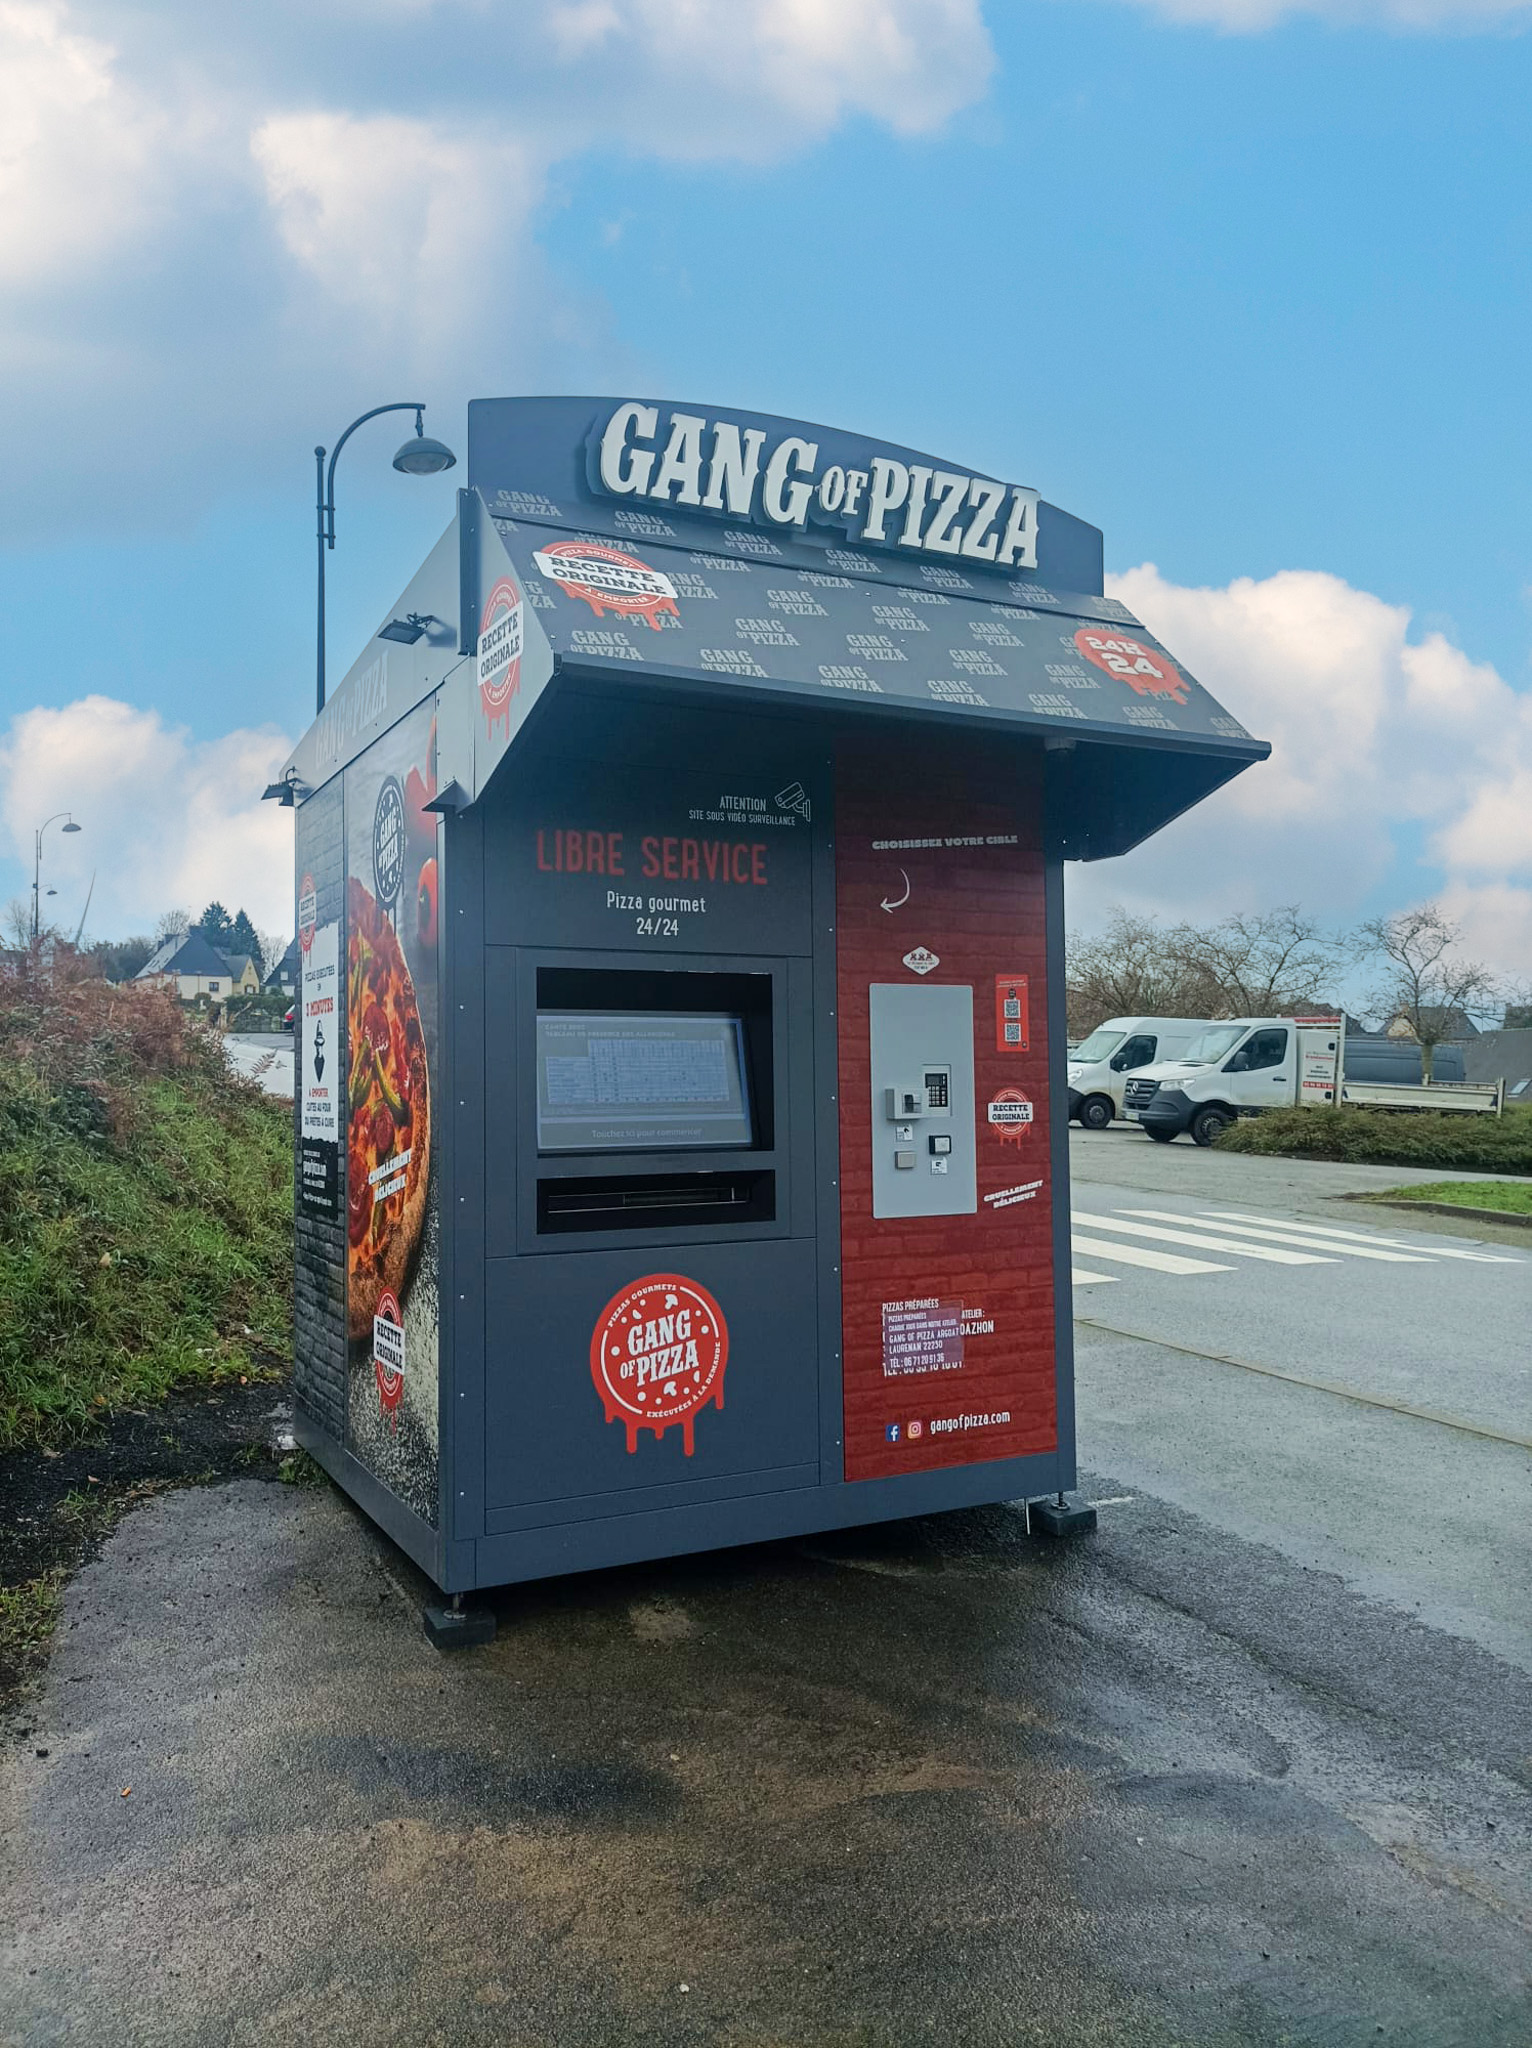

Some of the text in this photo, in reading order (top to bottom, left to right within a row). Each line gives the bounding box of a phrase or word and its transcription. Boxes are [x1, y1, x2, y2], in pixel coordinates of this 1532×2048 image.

[600, 402, 1041, 569] GANG OF PIZZA
[498, 490, 550, 504] GANG
[510, 502, 562, 516] PIZZA
[615, 511, 664, 525] GANG
[626, 523, 677, 537] PIZZA
[724, 531, 770, 543] GANG
[736, 542, 783, 555] PIZZA
[825, 549, 868, 561] GANG
[549, 556, 655, 582] RECETTE
[701, 558, 751, 572] PIZZA
[839, 560, 882, 573] PIZZA
[920, 566, 960, 578] GANG
[553, 568, 666, 594] ORIGINALE
[665, 572, 705, 586] ANG
[807, 575, 855, 588] PIZZA
[933, 577, 974, 589] PIZZA
[676, 585, 719, 599] IZZA
[767, 590, 815, 603] GANG
[907, 592, 951, 605] PIZZA
[780, 602, 829, 616] PIZZA
[872, 605, 917, 619] GANG
[735, 618, 786, 632] GANG
[885, 618, 930, 631] PIZZA
[968, 622, 1011, 634] GANG
[481, 611, 518, 654] RECETTE
[571, 630, 630, 645] GANG
[748, 632, 800, 646] PIZZA
[846, 634, 894, 647] GANG
[981, 634, 1025, 646] PIZZA
[1084, 636, 1147, 656] 24H
[480, 635, 520, 677] ORIGINALE
[584, 645, 644, 660] PIZZA
[700, 648, 754, 663] GANG
[860, 647, 909, 661] PIZZA
[949, 649, 994, 662] GANG
[713, 663, 770, 677] PIZZA
[818, 665, 869, 679] GANG
[963, 662, 1008, 676] PIZZA
[1044, 664, 1087, 676] GANG
[1101, 652, 1164, 679] 24
[832, 679, 885, 693] PIZZA
[927, 680, 975, 693] GANG
[1060, 677, 1102, 688] PIZZA
[352, 648, 388, 738] PIZZA
[941, 693, 991, 707] PIZZA
[1028, 694, 1072, 706] GANG
[719, 795, 767, 811] ATTENTION
[688, 809, 796, 826] SITE SOUS VIDÉO SURVEILLANCE
[380, 805, 397, 849] GANG
[872, 835, 1018, 850] CHOISISSEZ VOTRE CIBLE
[382, 831, 399, 875] PIZZA
[536, 830, 768, 885] LIBRE SERVICE
[607, 890, 706, 913] Pizza gourmet
[636, 917, 679, 936] 24/24
[992, 1104, 1028, 1112] RECETTE
[991, 1112, 1030, 1121] ORIGINALE
[983, 1179, 1044, 1202] CRUELLEMENT
[608, 1284, 677, 1327] PIZZAS GOURMETS
[882, 1297, 940, 1312] PIZZAS PRÉPARÉES
[888, 1314, 904, 1323] PIZZAS
[916, 1321, 928, 1329] DANS
[928, 1320, 941, 1328] NOTRE
[376, 1321, 402, 1348] RECETTE
[627, 1308, 691, 1356] GANG
[889, 1327, 959, 1344] GANG OF PIZZA ARGOAT
[376, 1341, 402, 1370] ORIGINALE
[889, 1343, 921, 1354] LAURENAN
[620, 1339, 699, 1387] OF PIZZA
[904, 1356, 913, 1367] 06
[913, 1355, 920, 1366] 71
[921, 1354, 928, 1364] 20
[646, 1341, 720, 1418] EXÉCUTÉES À LA DEMANDE
[930, 1411, 1011, 1434] gangofpizza.com
